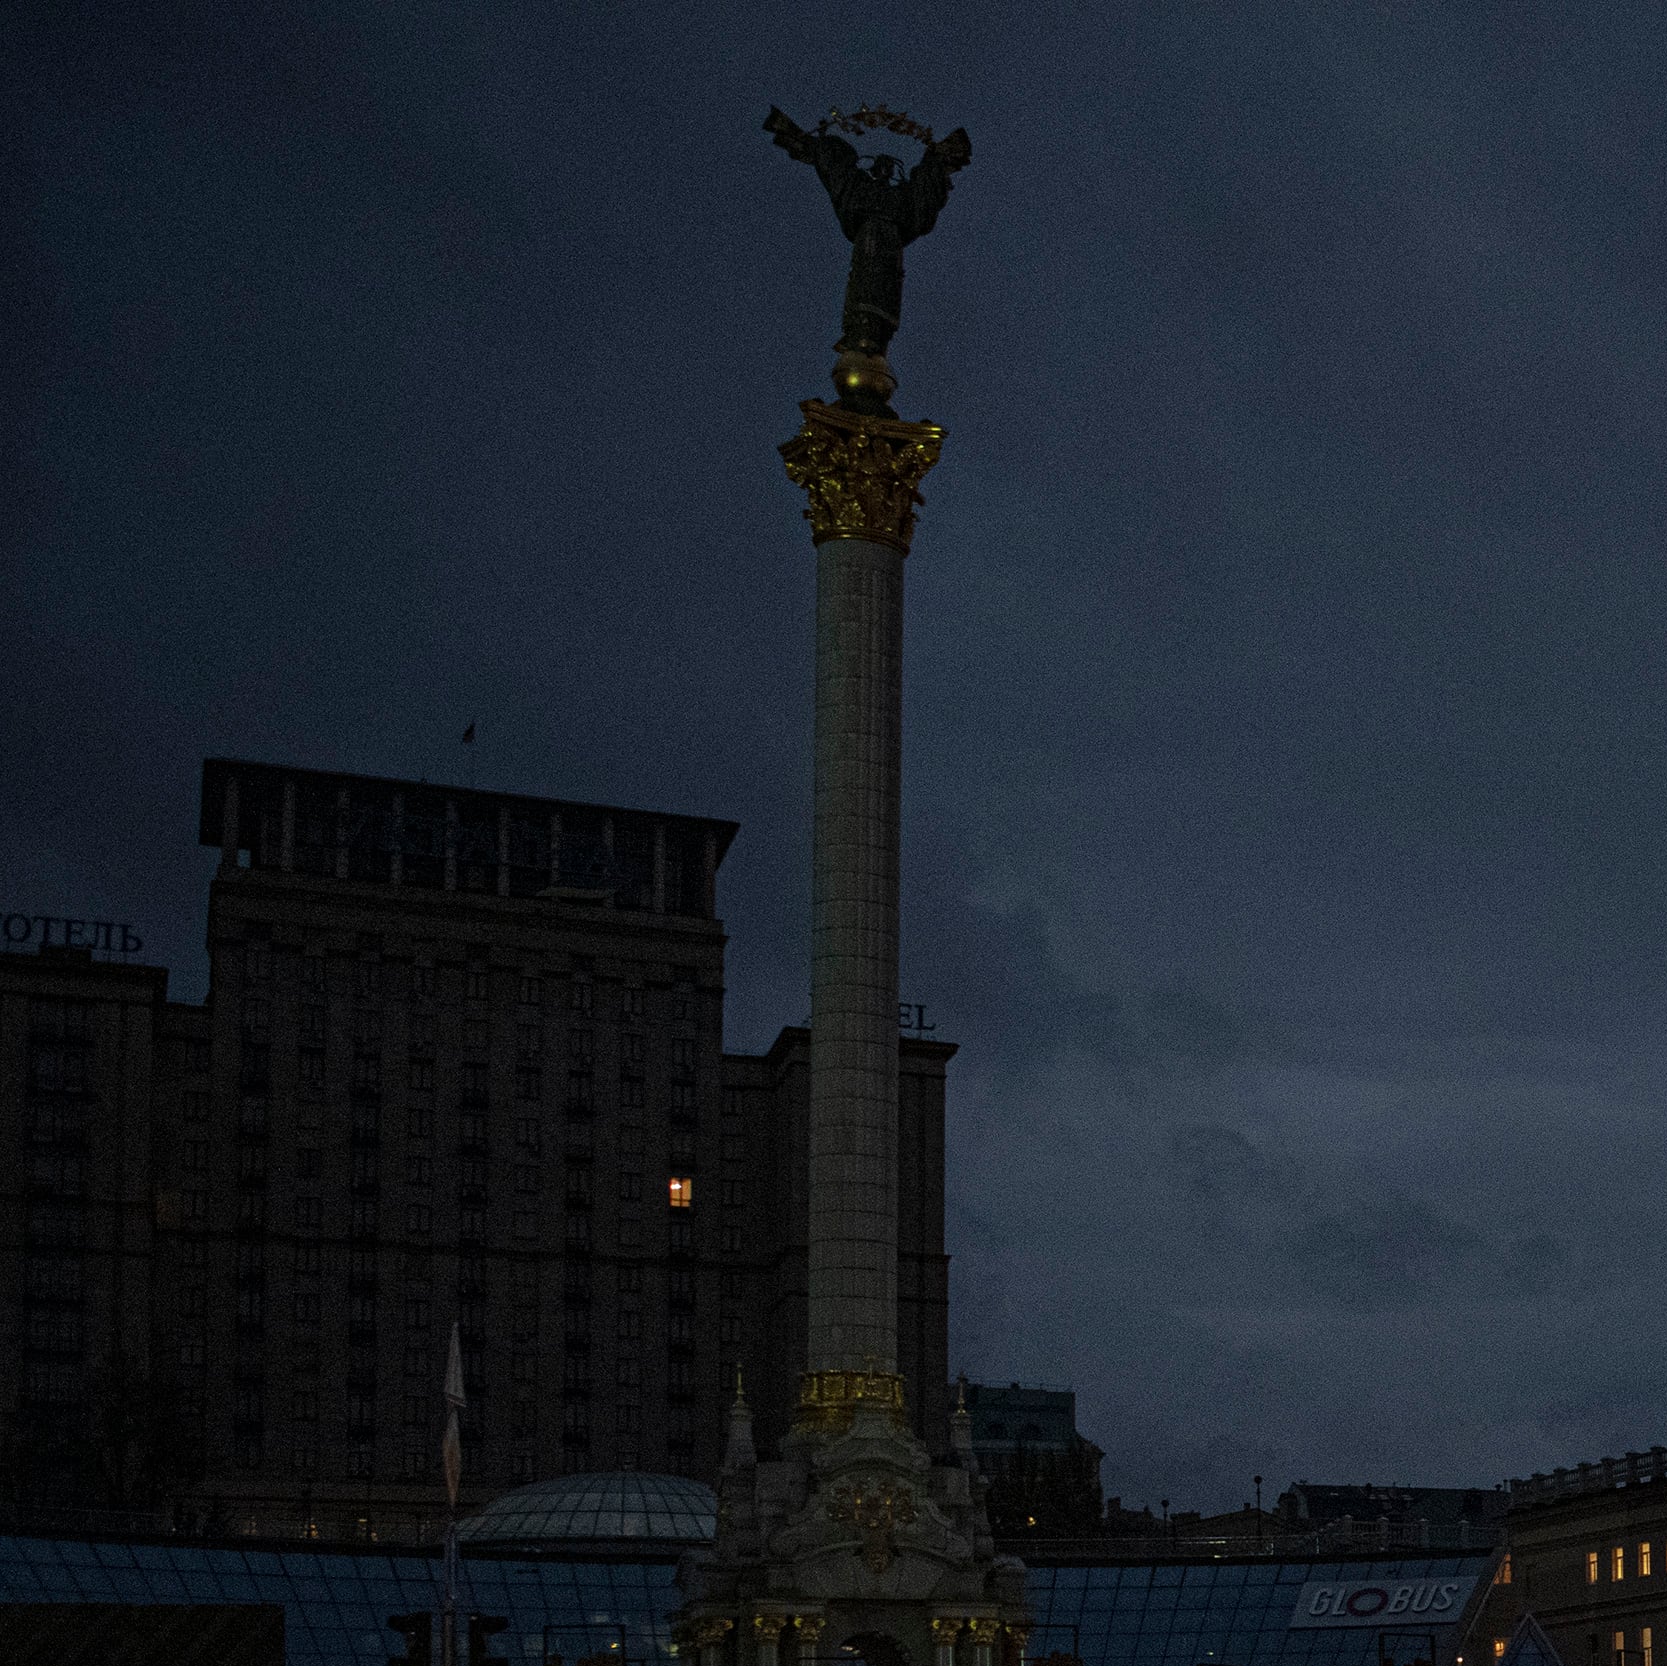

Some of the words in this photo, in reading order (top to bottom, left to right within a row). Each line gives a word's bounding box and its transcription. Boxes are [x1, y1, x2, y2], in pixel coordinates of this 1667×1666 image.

[0, 912, 143, 952] ОТЕЛЬ
[898, 1003, 936, 1031] EL
[1308, 1583, 1459, 1617] GLOBUS
